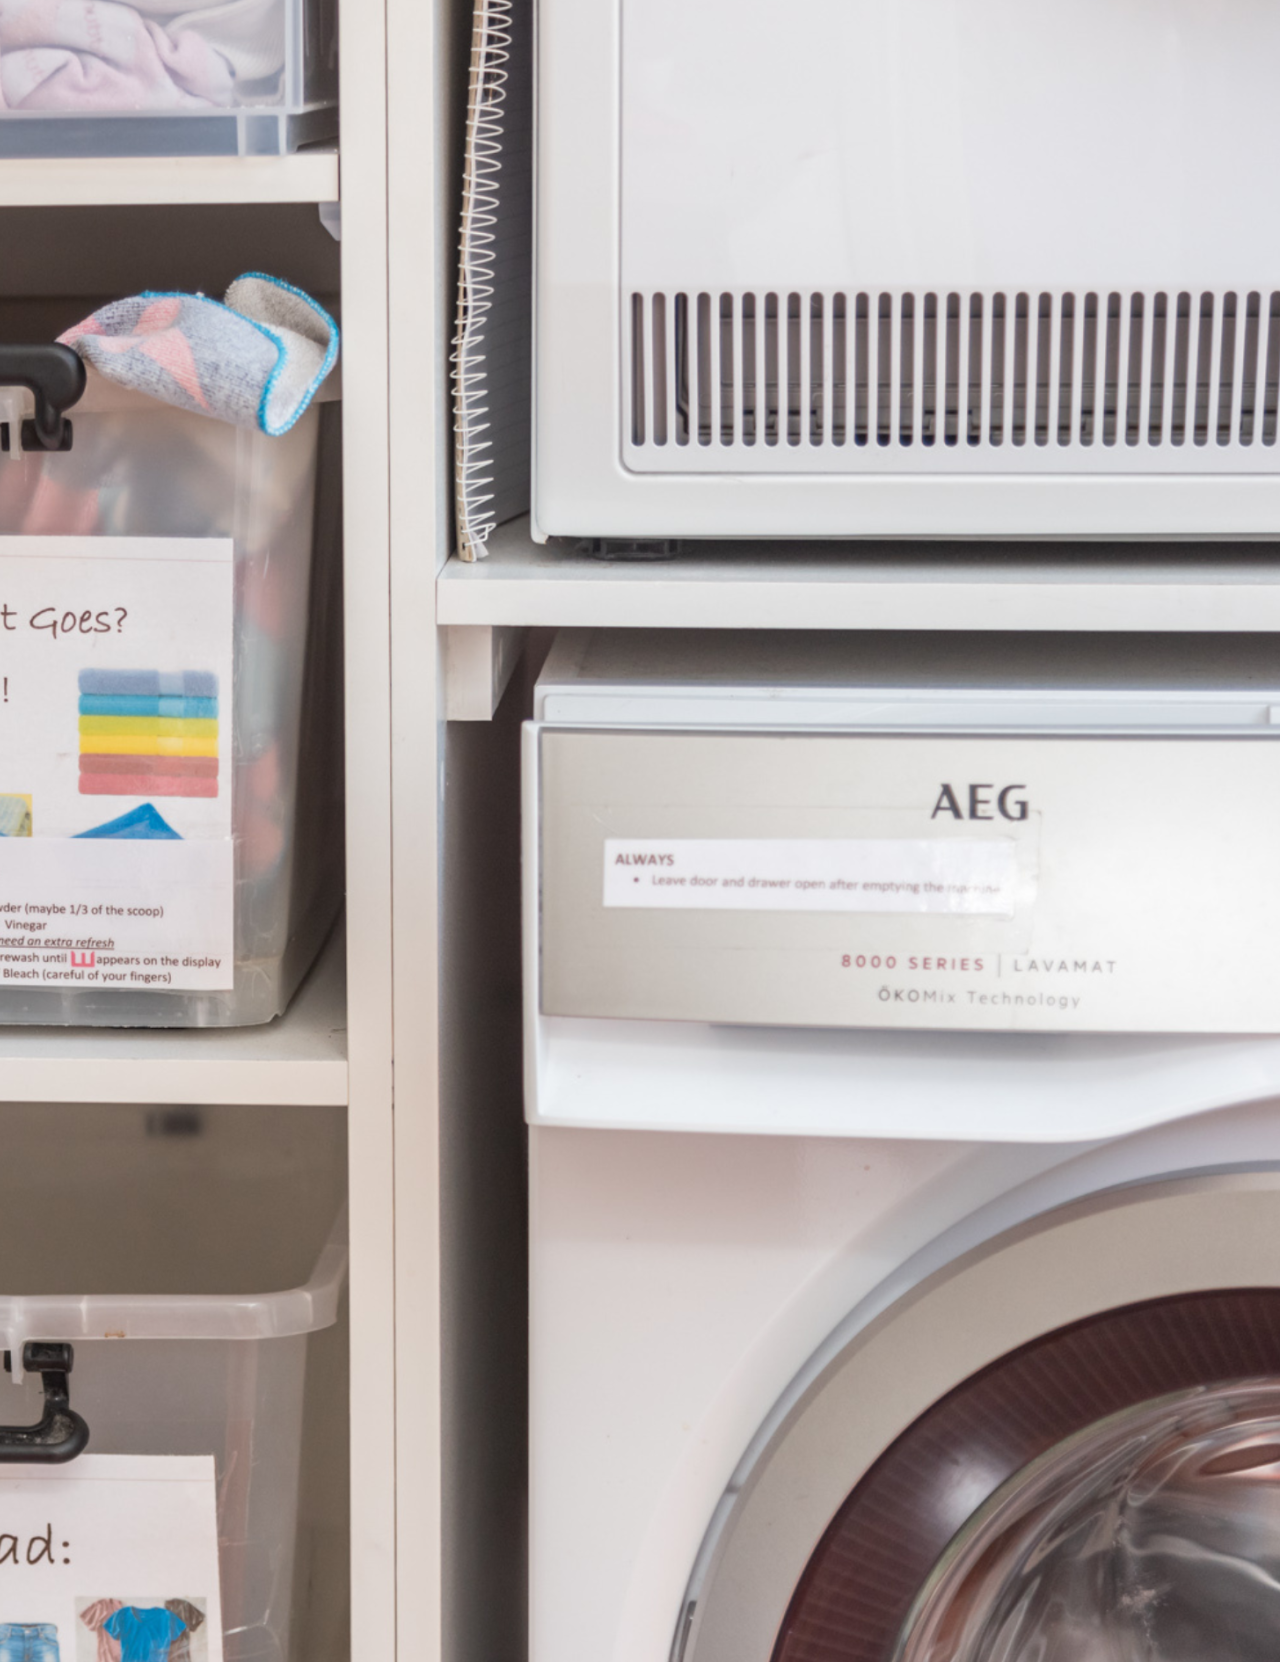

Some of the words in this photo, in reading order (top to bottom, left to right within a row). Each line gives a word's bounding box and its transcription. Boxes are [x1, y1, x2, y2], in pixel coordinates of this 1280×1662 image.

[28, 606, 128, 640] Goes?
[931, 783, 1029, 822] AEG
[615, 853, 675, 866] ALWAYS
[651, 875, 687, 886] Leave
[689, 875, 719, 887] door
[721, 876, 745, 888] and
[747, 877, 791, 889] drawer
[794, 879, 824, 891] open
[828, 878, 859, 891] after
[861, 881, 921, 895] emptying
[922, 881, 945, 893] the
[24, 903, 67, 916] (maybe
[69, 903, 89, 916] 1/3
[90, 904, 103, 916] of
[105, 905, 125, 916] the
[126, 906, 164, 918] scoop)
[4, 919, 48, 933] Vinegar
[27, 938, 43, 948] an
[42, 937, 73, 949] extra
[73, 936, 115, 950] refresh
[42, 953, 68, 964] until
[96, 956, 141, 967] appears
[142, 957, 158, 966] on
[160, 955, 180, 967] the
[181, 956, 222, 969] display
[840, 953, 897, 970] 8000
[908, 956, 984, 972] SERIES
[1013, 959, 1116, 973] LAVAMAT
[2, 968, 40, 979] Bleach
[42, 968, 85, 981] (careful
[87, 969, 100, 981] of
[101, 972, 128, 983] your
[129, 970, 172, 985] fingers)
[965, 989, 1080, 1010] Technology
